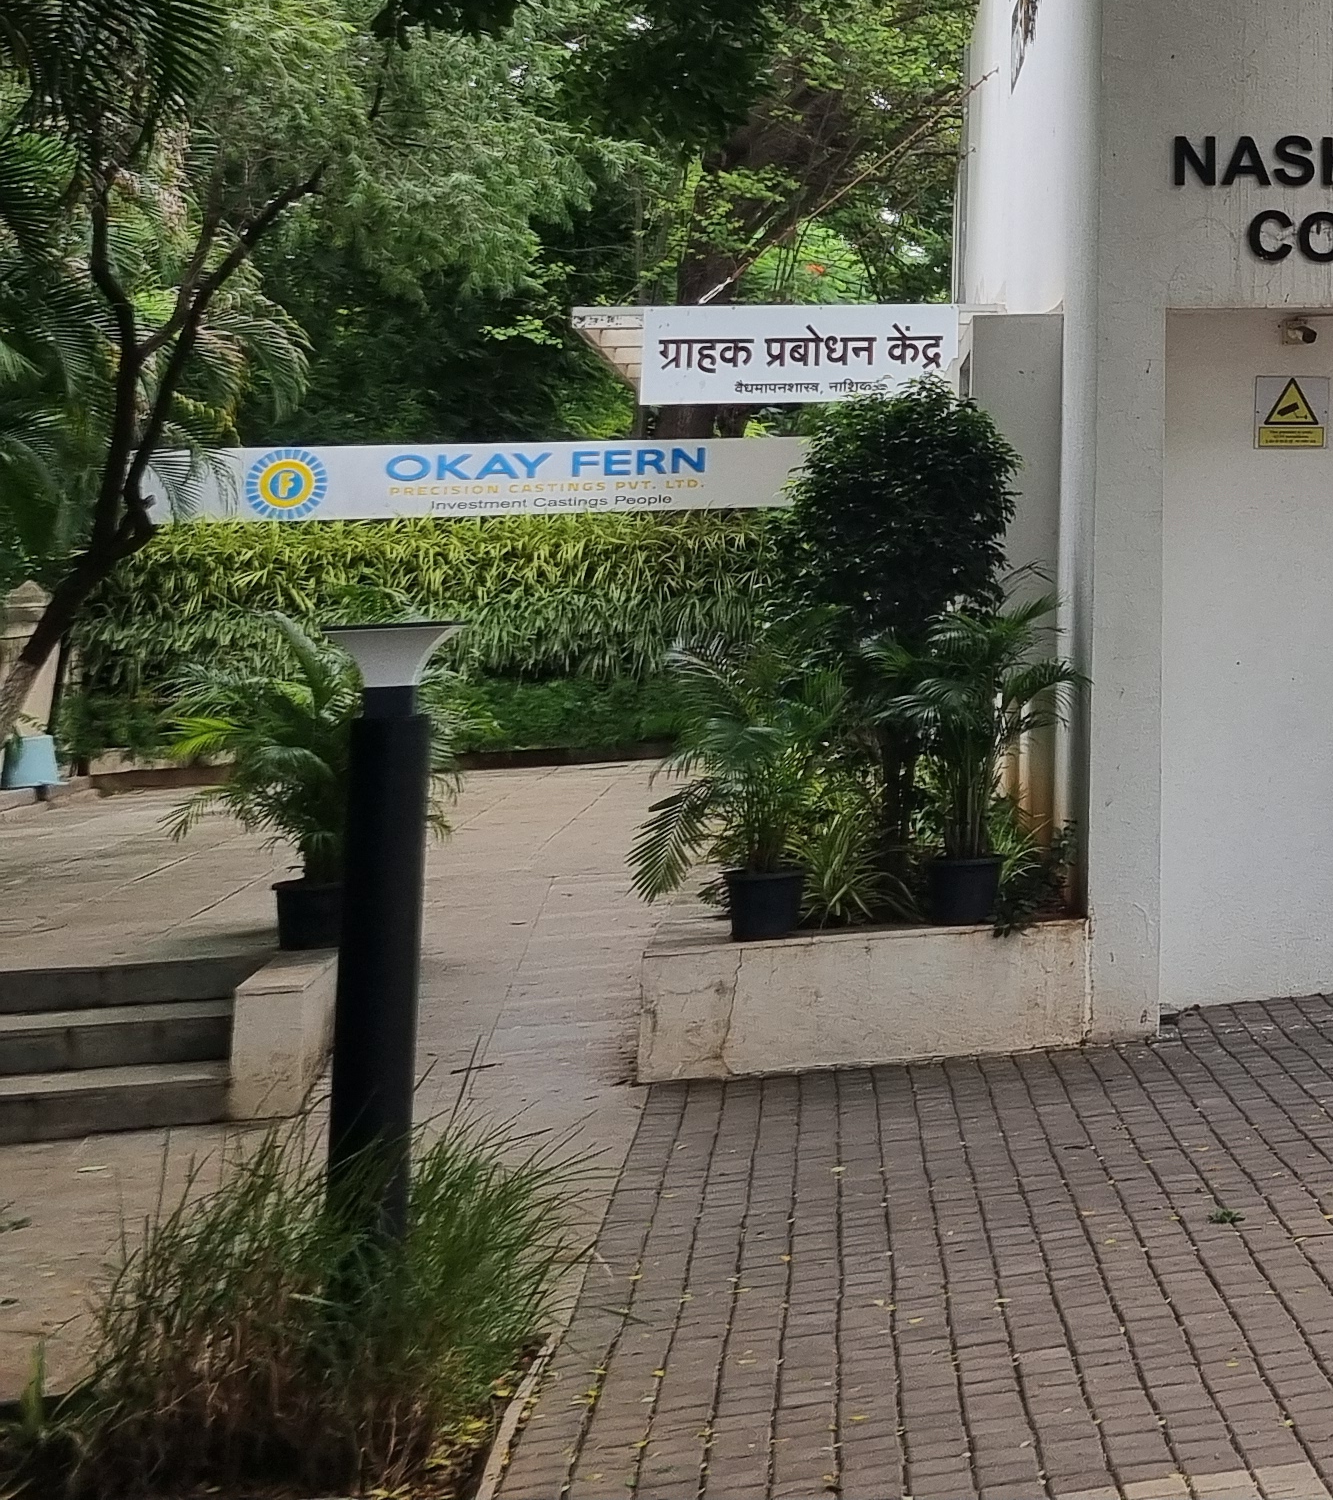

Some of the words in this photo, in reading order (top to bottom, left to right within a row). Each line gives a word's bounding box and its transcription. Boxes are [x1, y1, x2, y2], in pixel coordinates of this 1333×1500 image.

[658, 337, 755, 374] ग्राहक
[764, 323, 877, 368] प्रबोधन
[886, 322, 944, 369] केंद्र
[385, 451, 552, 482] OKAY
[571, 446, 707, 478] FERN
[389, 483, 499, 497] PRECISION
[509, 481, 606, 494] CASTINGS
[616, 480, 656, 491] PVT.
[666, 478, 706, 489] LTD.
[431, 497, 528, 511] Investment
[533, 495, 608, 509] Castings
[615, 494, 673, 506] People
